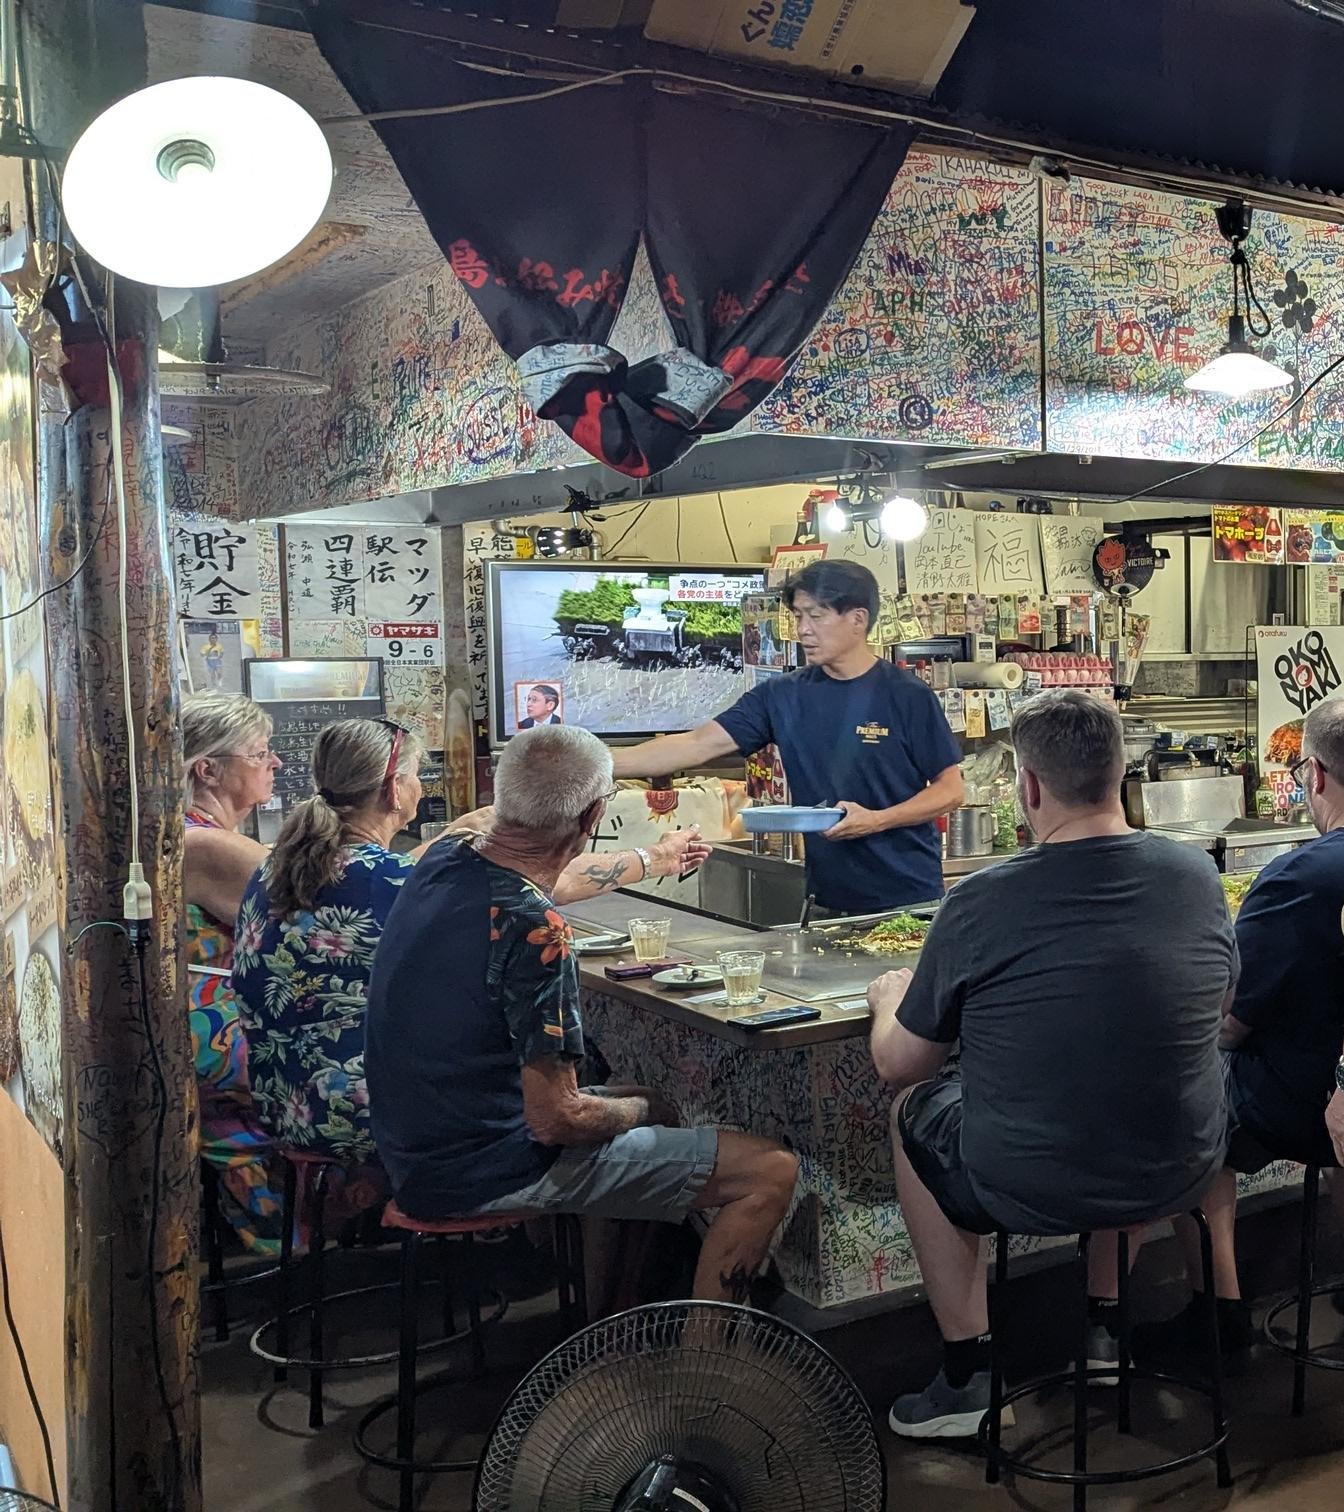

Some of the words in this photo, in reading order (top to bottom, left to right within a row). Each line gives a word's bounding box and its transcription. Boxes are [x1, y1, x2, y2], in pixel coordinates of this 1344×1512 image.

[192, 528, 251, 615] 貯金
[323, 533, 361, 617] 四連覇
[366, 535, 400, 584] 駅伝
[404, 537, 435, 617] マツダ
